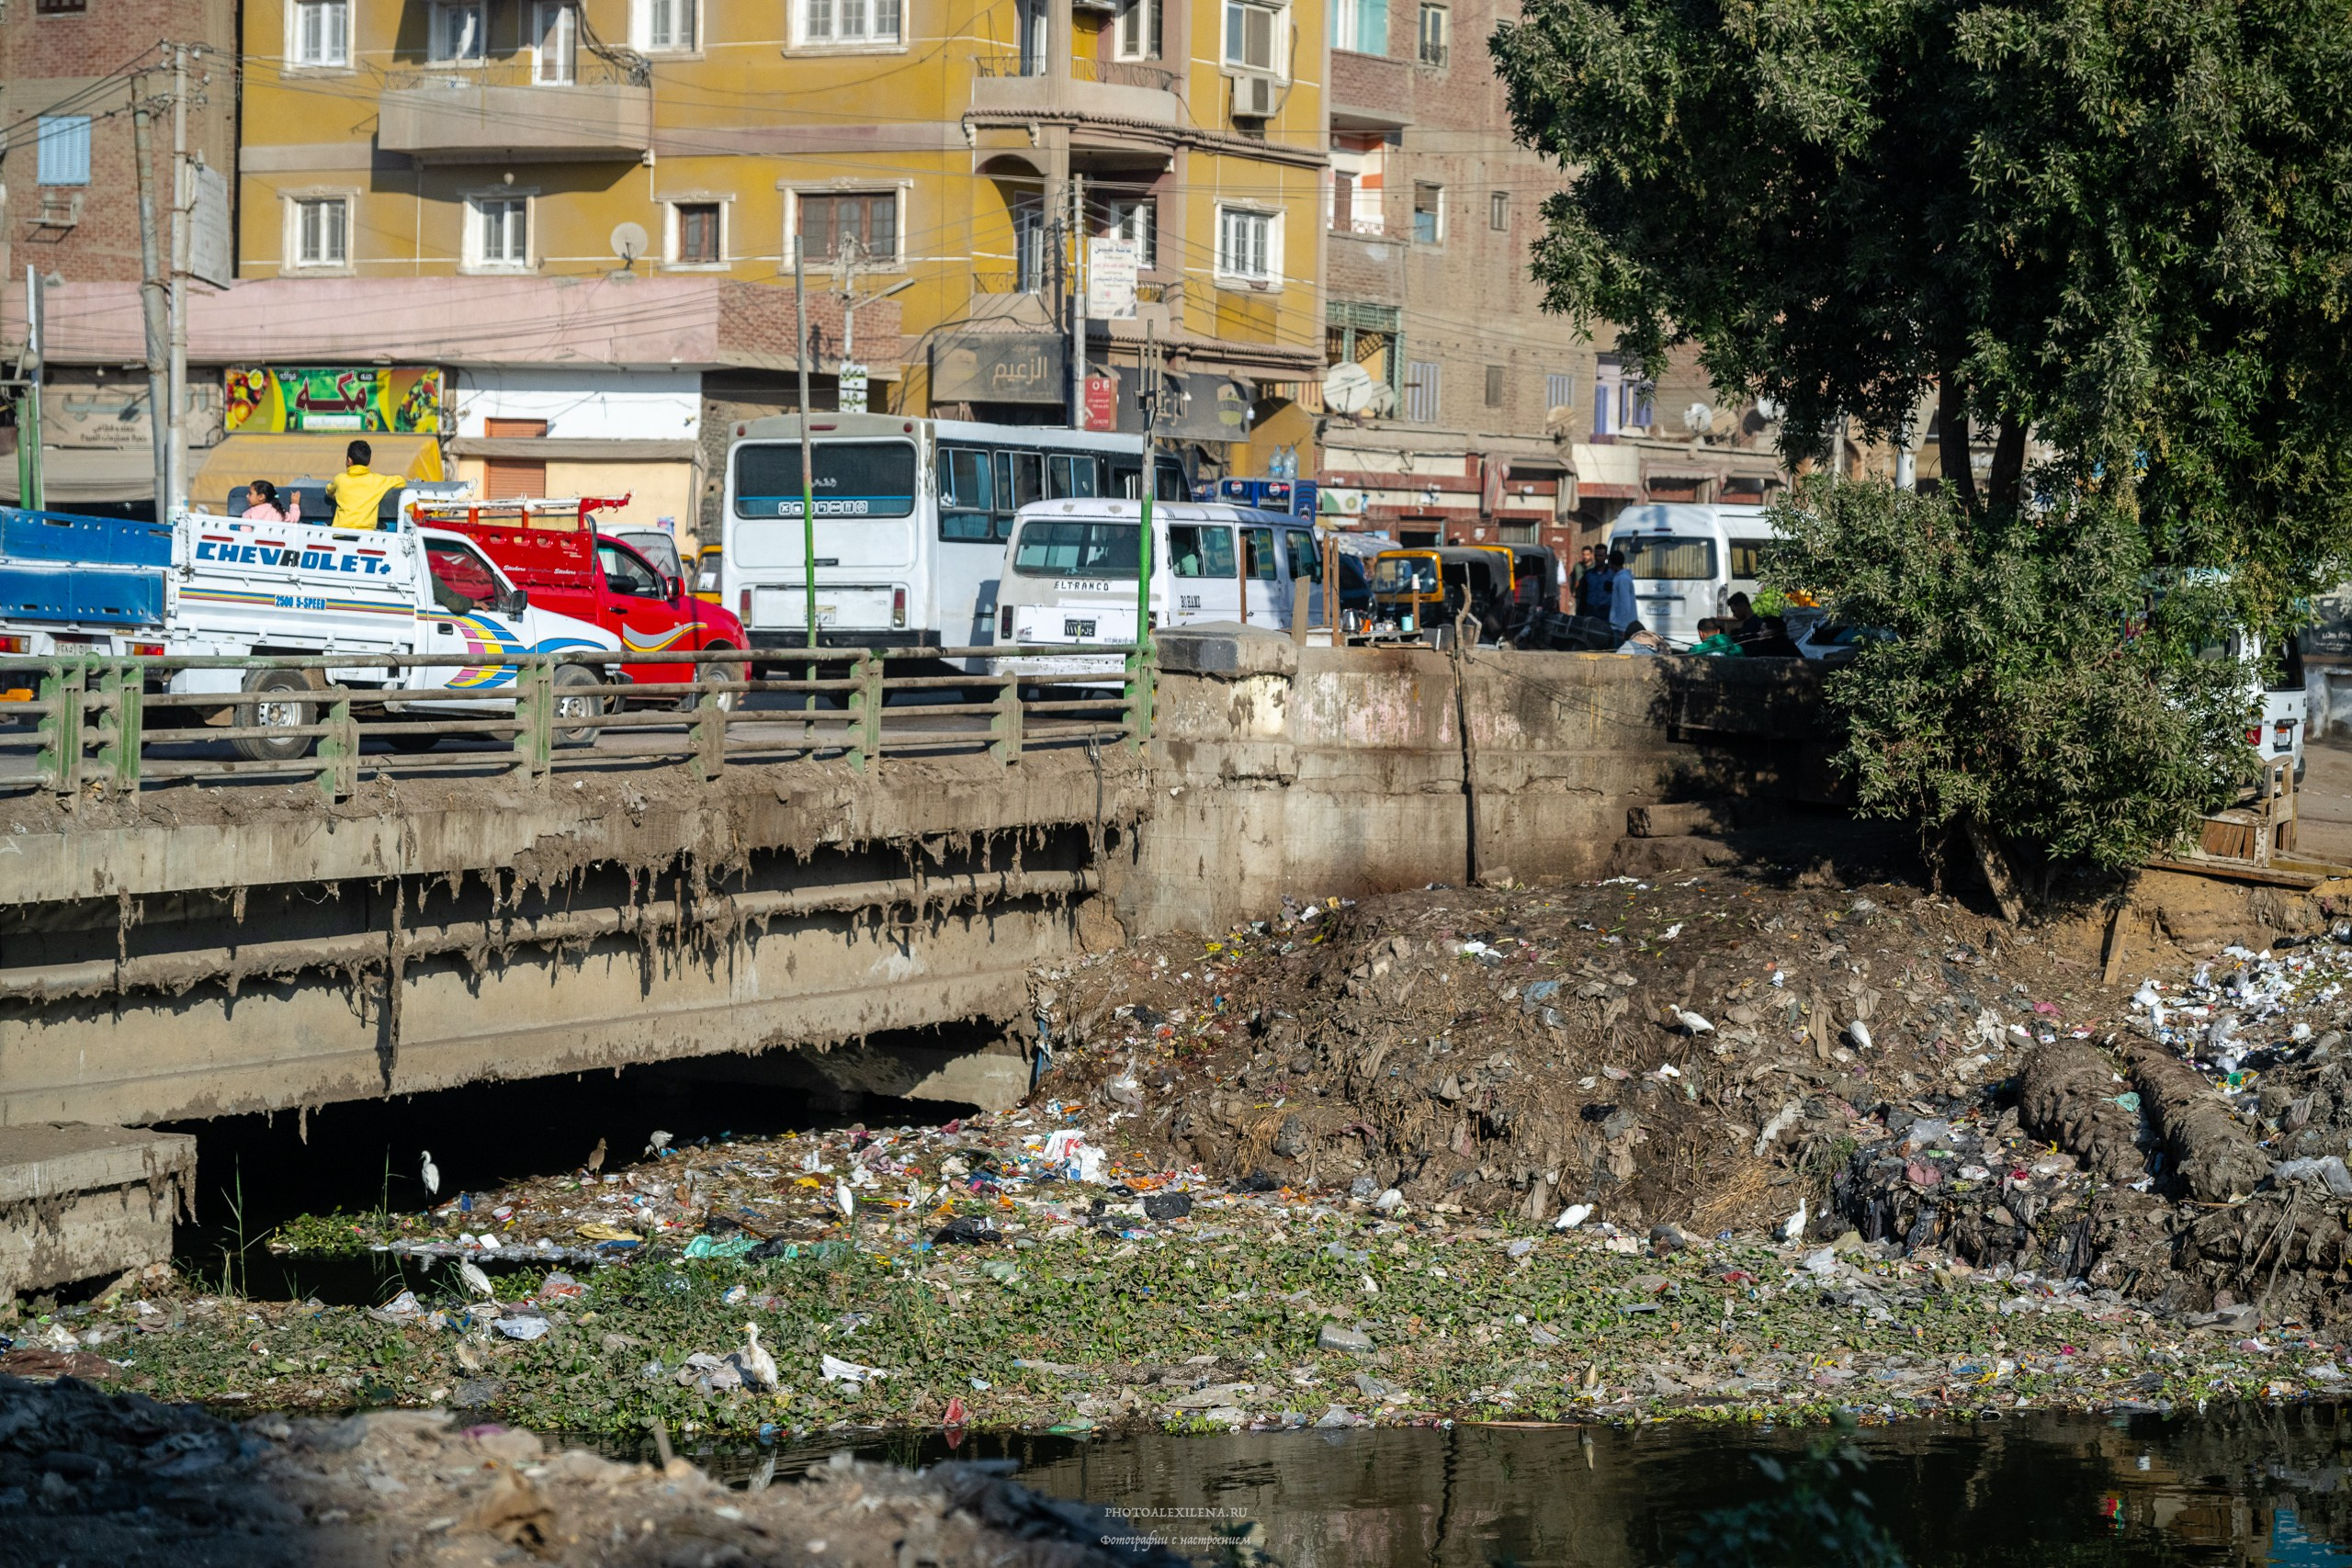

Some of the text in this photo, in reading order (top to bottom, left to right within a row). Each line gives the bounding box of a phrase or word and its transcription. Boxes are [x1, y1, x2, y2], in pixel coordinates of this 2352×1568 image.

[992, 355, 1048, 387] الزعيم
[196, 541, 383, 574] CHEVROLET
[276, 594, 326, 610] 2500 5-SPEED
